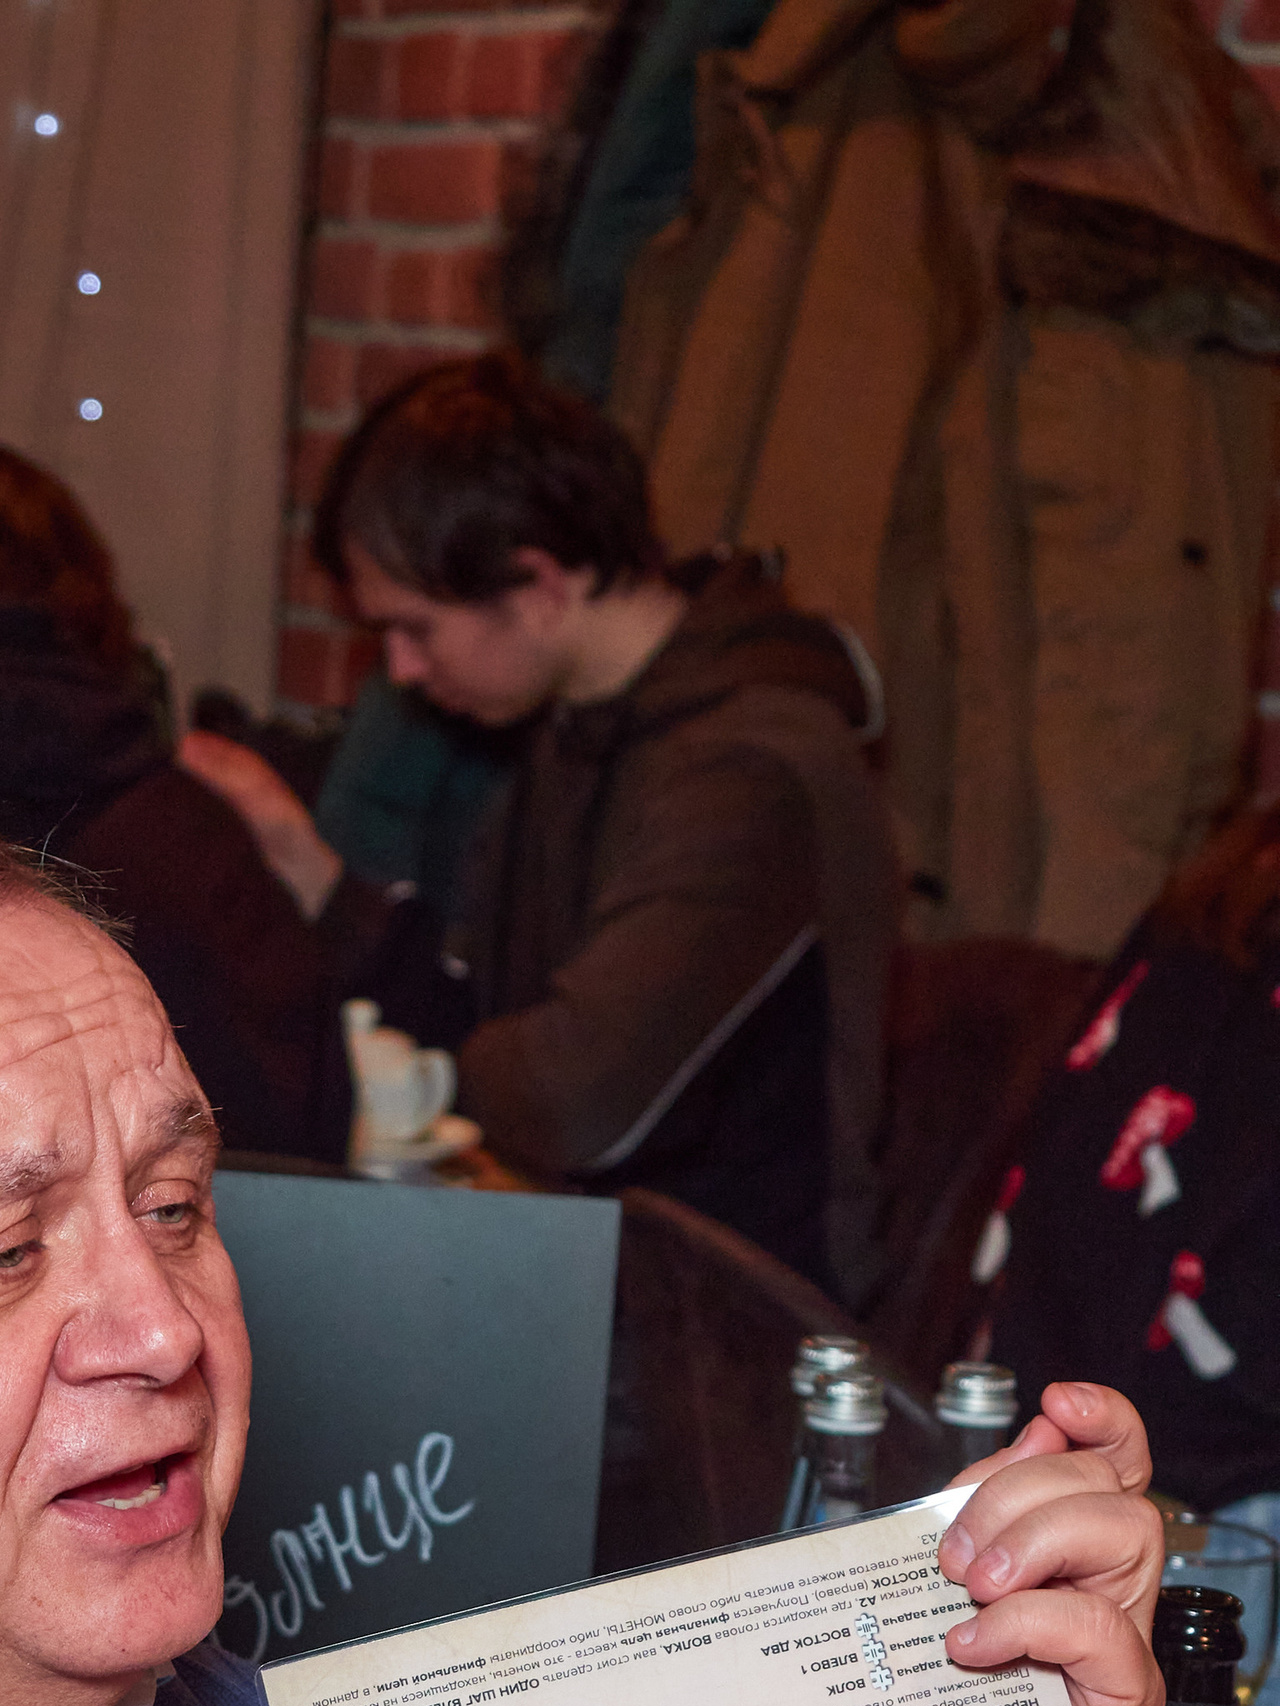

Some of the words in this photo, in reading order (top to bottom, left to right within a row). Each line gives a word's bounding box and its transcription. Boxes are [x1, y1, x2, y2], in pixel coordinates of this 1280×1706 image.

[881, 1609, 928, 1626] задача
[792, 1627, 851, 1649] ВОСТОК
[889, 1634, 935, 1651] задача
[759, 1639, 789, 1656] ДВА
[800, 1664, 807, 1674] 1
[810, 1652, 858, 1672] ВЛЕВО
[896, 1659, 943, 1676] задача
[825, 1677, 866, 1696] ВОЛК
[988, 1682, 1034, 1697] баллы.
